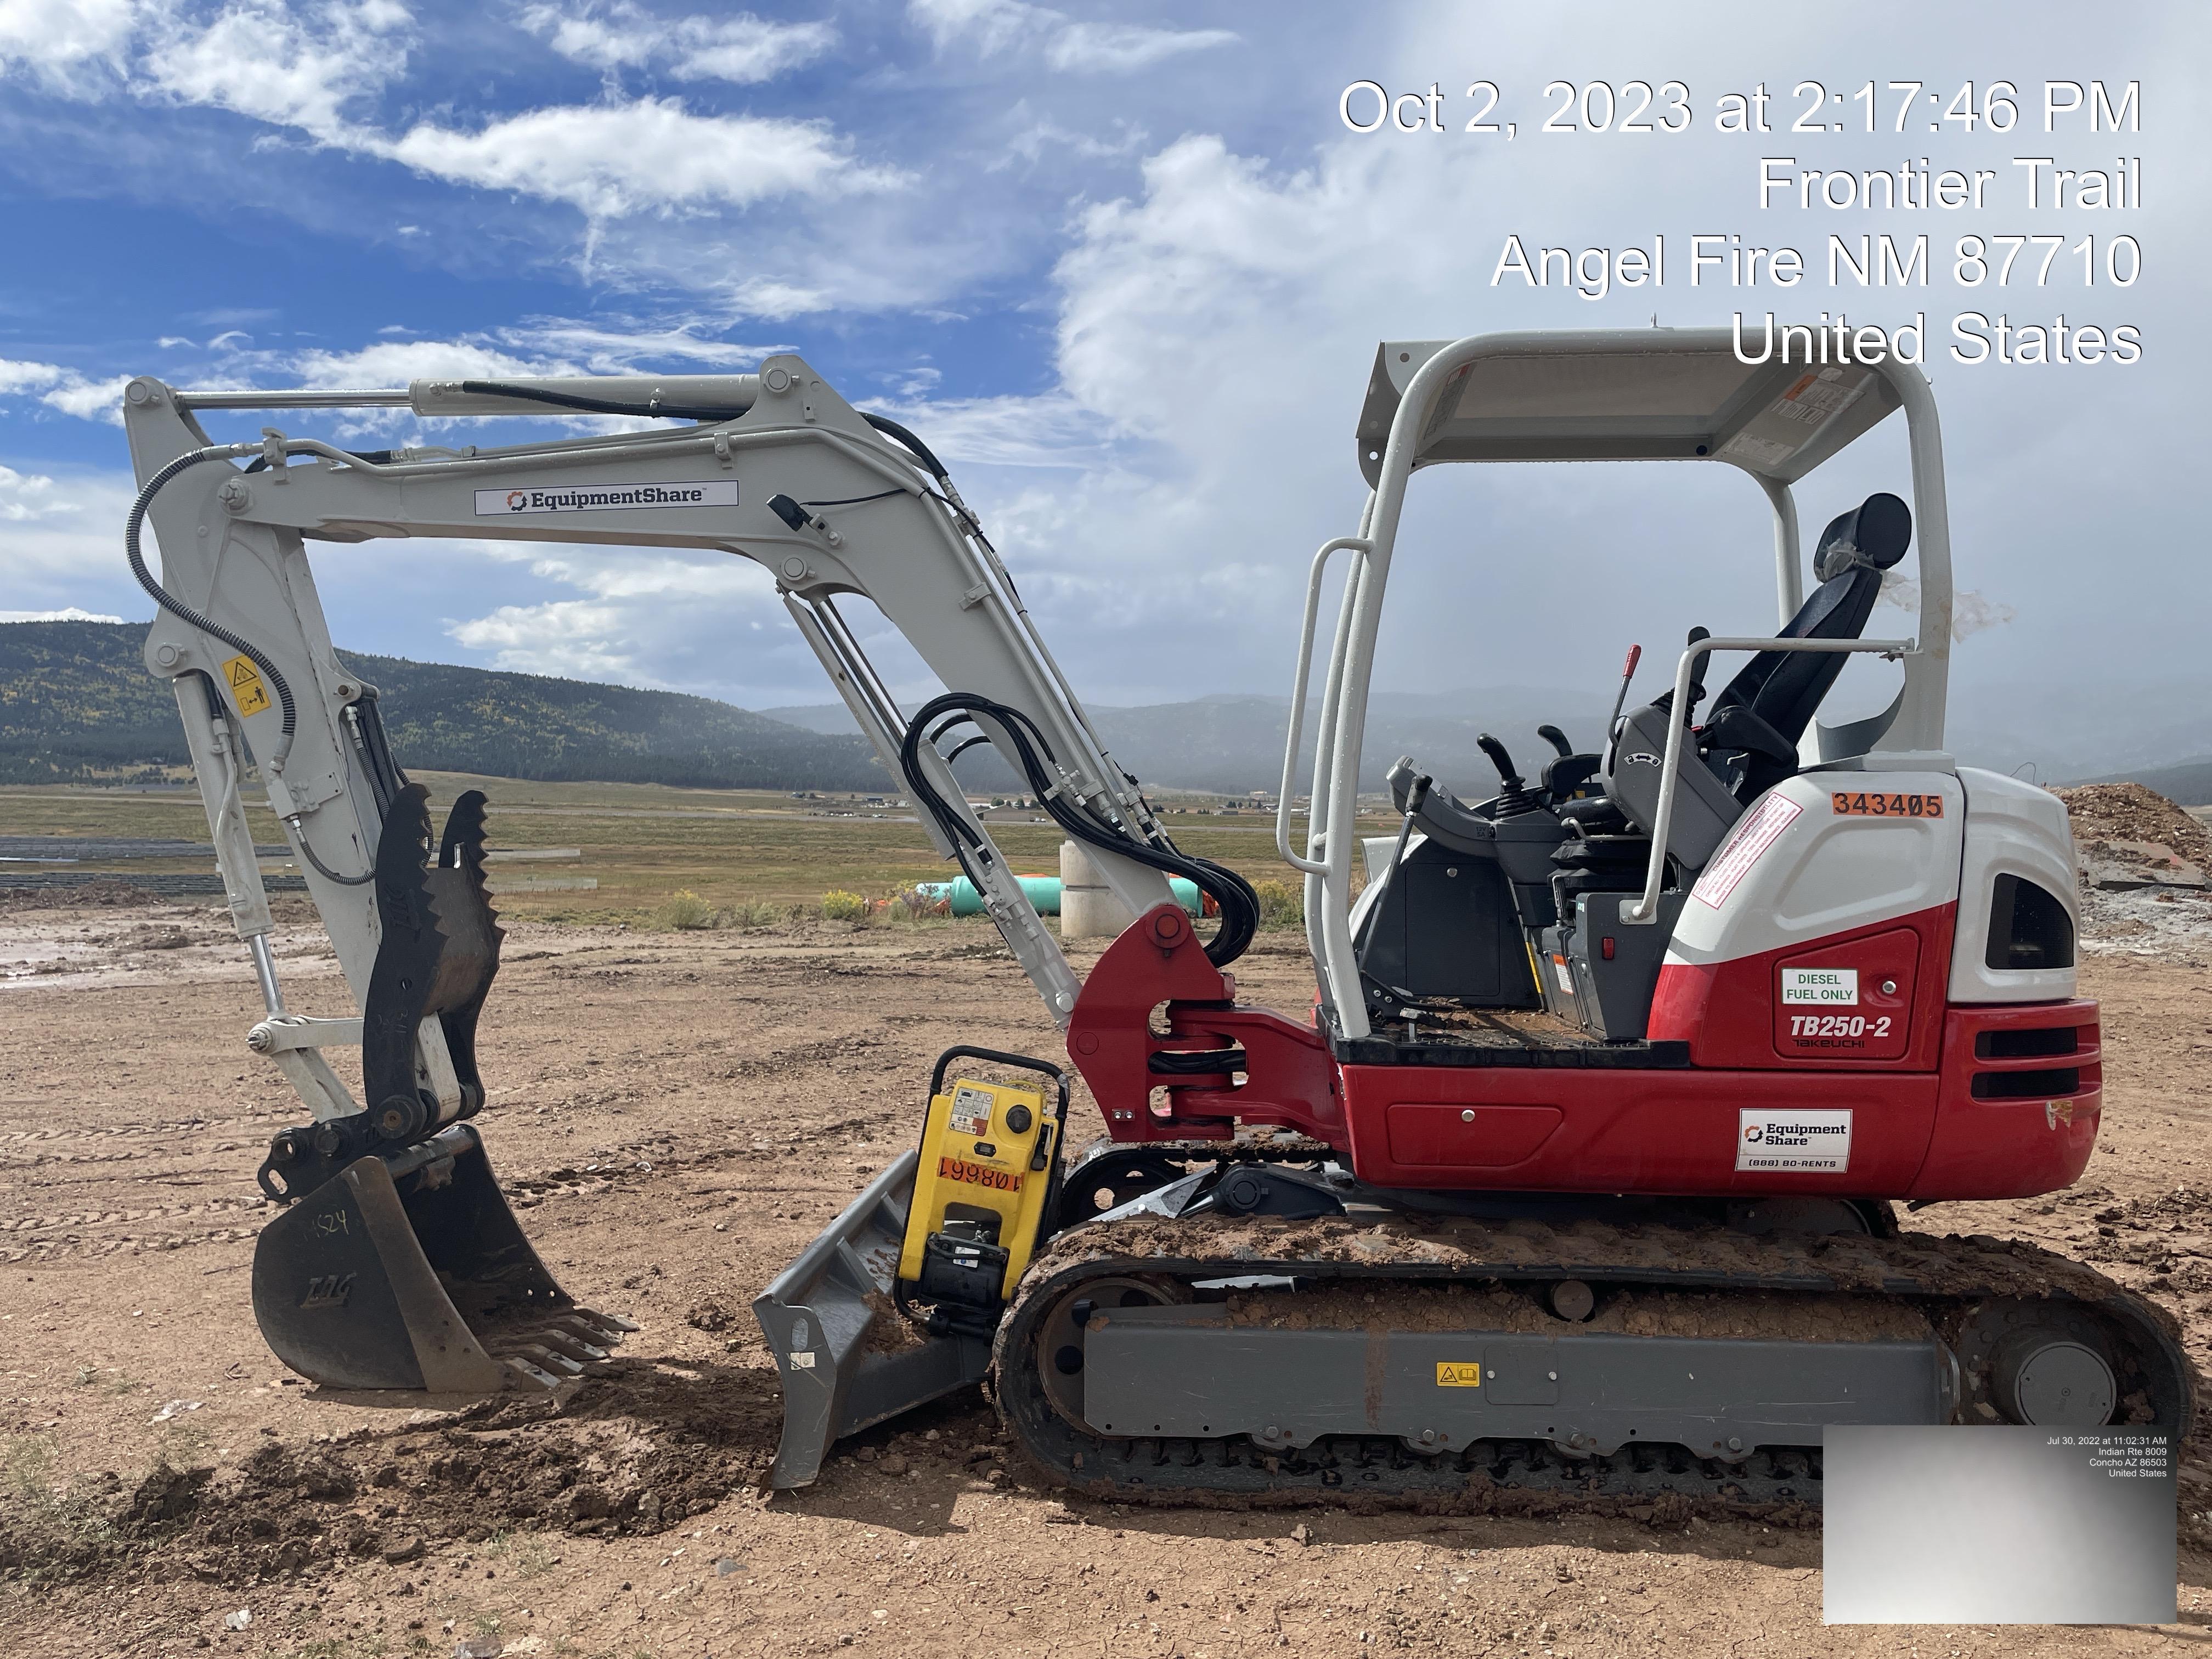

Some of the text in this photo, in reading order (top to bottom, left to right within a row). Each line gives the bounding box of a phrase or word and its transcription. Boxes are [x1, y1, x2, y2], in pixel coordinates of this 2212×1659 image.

[1834, 793, 1942, 817] 343405
[1712, 795, 1778, 871] CUSTOMER RESPONSIBILITY
[1798, 974, 1841, 984] DIESEL
[1787, 989, 1853, 1000] FUEL ONLY
[1791, 1015, 1891, 1037] TB250-2
[1766, 1124, 1846, 1136] Equipment
[1765, 1136, 1808, 1146] Share
